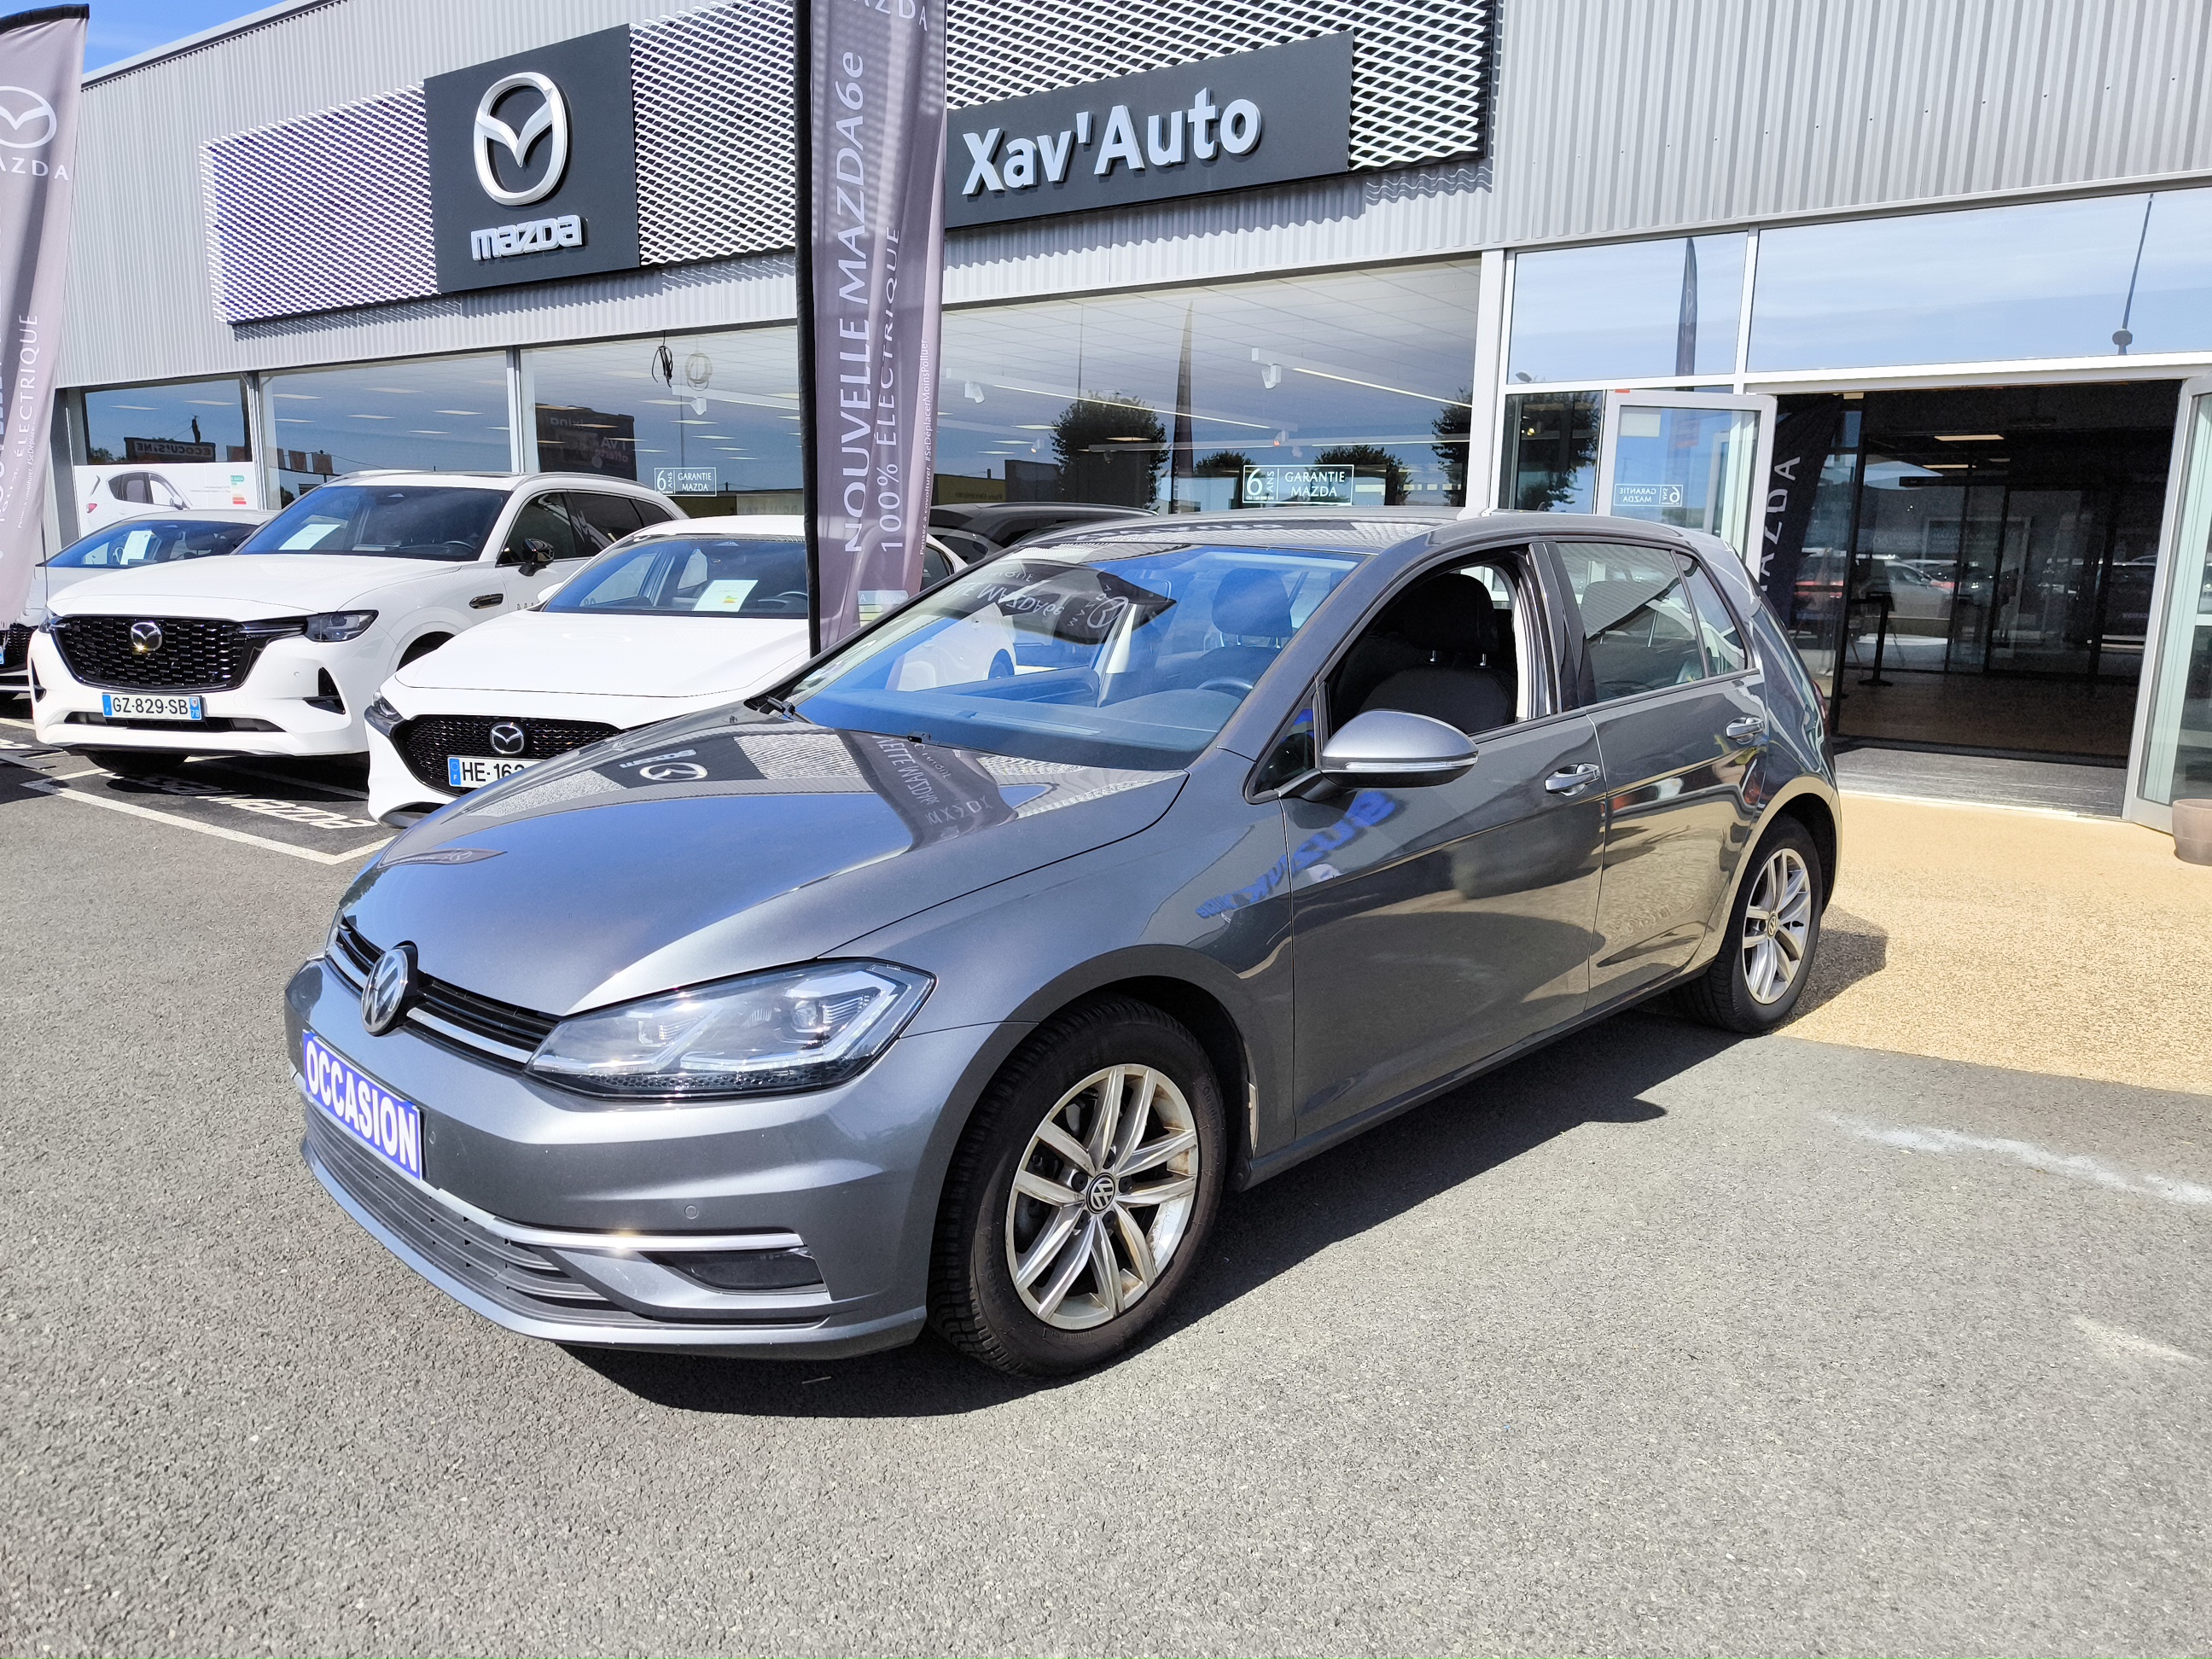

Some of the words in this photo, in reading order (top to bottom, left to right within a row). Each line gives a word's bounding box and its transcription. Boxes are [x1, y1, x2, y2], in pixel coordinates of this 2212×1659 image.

[864, 0, 928, 32] ZDA
[962, 87, 1261, 195] Xav'Auto
[0, 156, 69, 181] ZDA
[835, 51, 868, 305] MAZDA6e
[839, 317, 871, 551] NOUVELLE
[656, 469, 667, 491] 6
[678, 472, 713, 481] GARANTIE
[681, 483, 709, 492] MAZDA
[1246, 468, 1263, 496] 6
[1266, 470, 1275, 492] ANS
[1284, 471, 1346, 483] GARANTIE
[1290, 486, 1337, 497] MAZDA
[190, 709, 200, 718] 79
[306, 1039, 418, 1173] OCCASION
